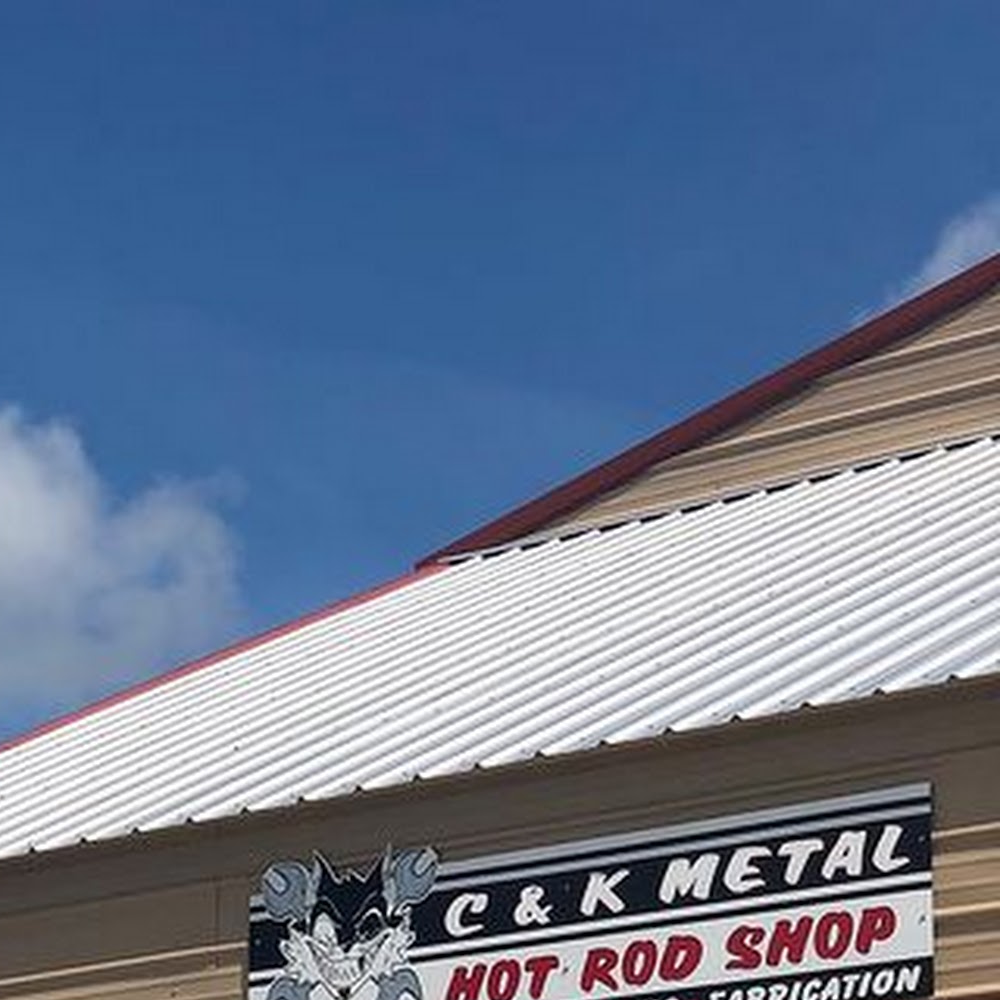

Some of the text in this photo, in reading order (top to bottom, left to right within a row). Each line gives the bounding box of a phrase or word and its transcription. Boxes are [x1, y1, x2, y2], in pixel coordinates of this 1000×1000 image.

[444, 824, 911, 939] C & K METAL
[579, 932, 703, 992] ROD
[724, 905, 899, 973] SHOP
